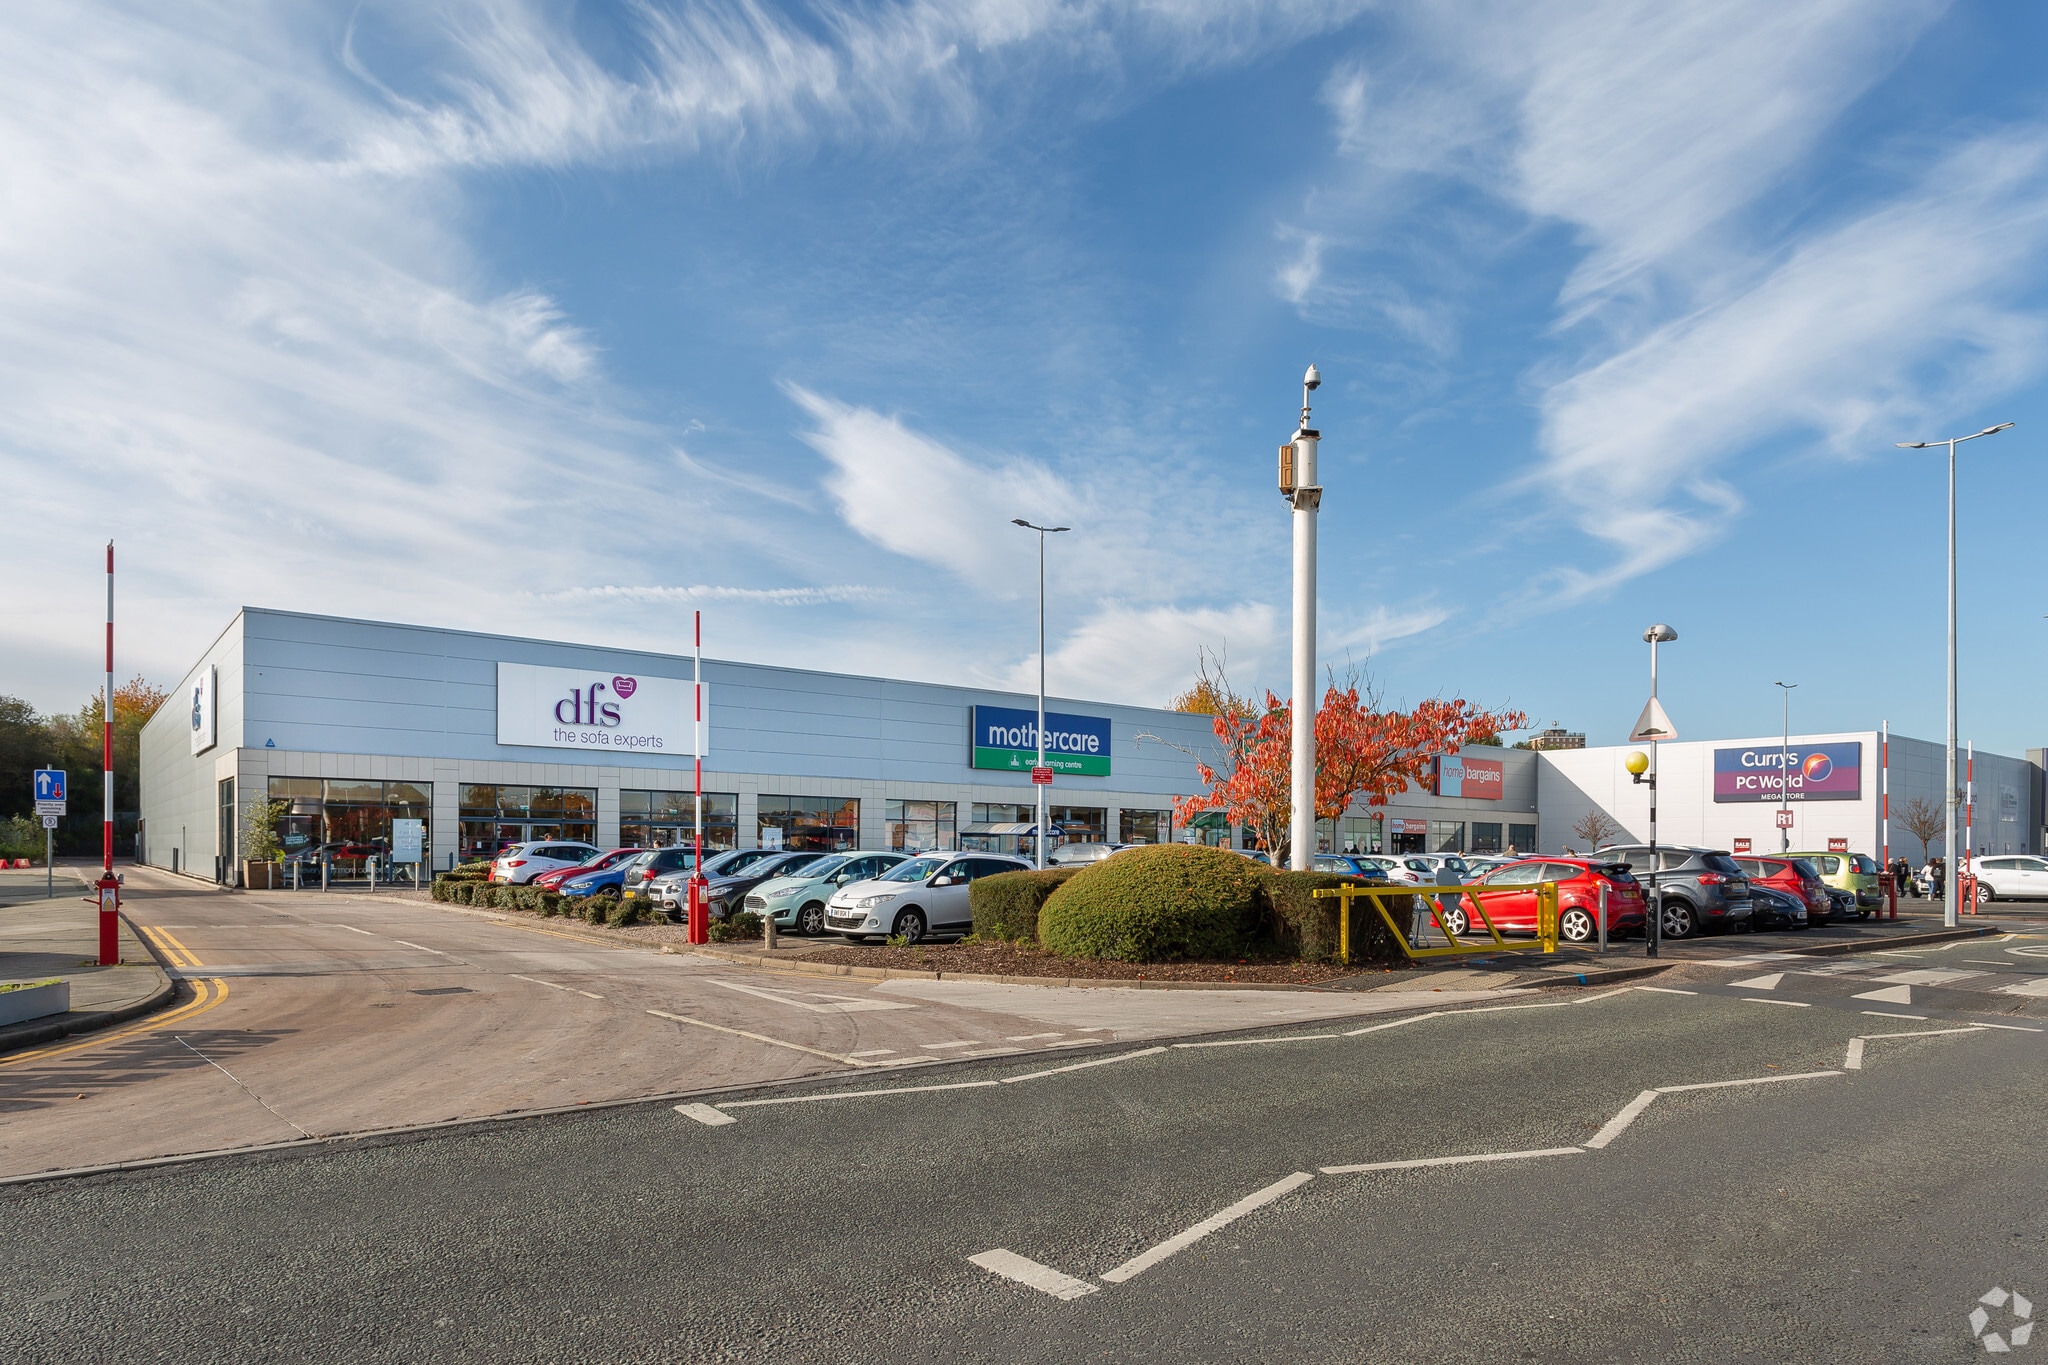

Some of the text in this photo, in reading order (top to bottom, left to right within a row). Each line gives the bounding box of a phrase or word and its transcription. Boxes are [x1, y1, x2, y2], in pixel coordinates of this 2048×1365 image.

[554, 682, 621, 728] dfs
[553, 727, 663, 749] the sofa experts
[989, 722, 1099, 753] mothercare
[1065, 760, 1082, 769] centre
[1741, 751, 1798, 769] Currys
[1443, 764, 1501, 783] home bargains
[1736, 775, 1757, 790] PC
[1405, 822, 1426, 831] bargains
[1777, 813, 1793, 825] R1
